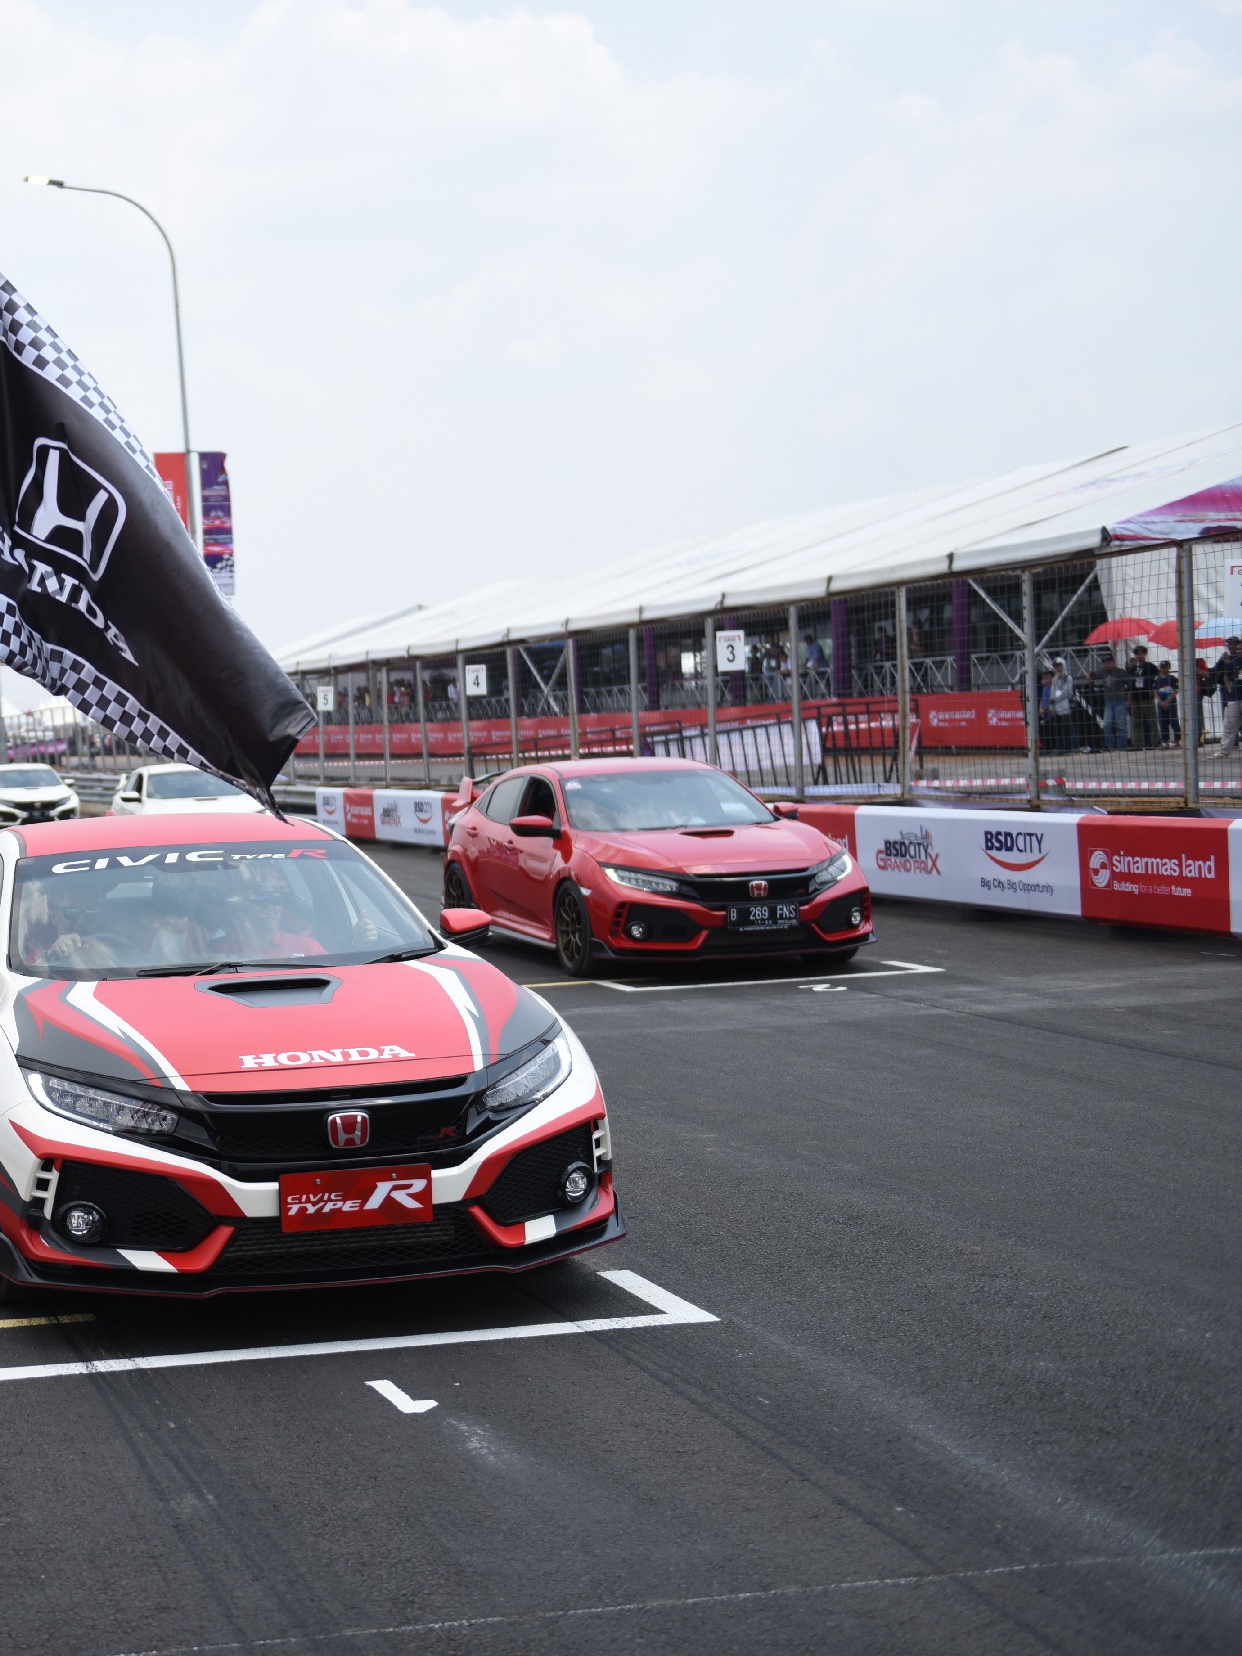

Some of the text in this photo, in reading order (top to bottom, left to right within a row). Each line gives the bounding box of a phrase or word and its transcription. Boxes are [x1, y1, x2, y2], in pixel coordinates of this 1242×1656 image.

[726, 643, 736, 663] 3
[472, 673, 480, 688] 4
[323, 693, 329, 706] 5
[884, 839, 930, 860] BSDCITY
[984, 830, 1045, 854] BSDCITY
[51, 850, 225, 874] CIVIC
[286, 848, 330, 859] R
[876, 850, 912, 873] GRAND
[1112, 850, 1216, 878] sinarmas land
[980, 876, 992, 891] Big
[1006, 879, 1018, 893] Big
[1018, 880, 1054, 897] Opportunity
[1113, 880, 1139, 895] Building
[1171, 884, 1192, 897] future
[730, 904, 796, 921] B 269 FNS
[238, 1044, 416, 1069] HONDA
[286, 1178, 428, 1216] TYPE R
[287, 1191, 343, 1203] CIVIC
